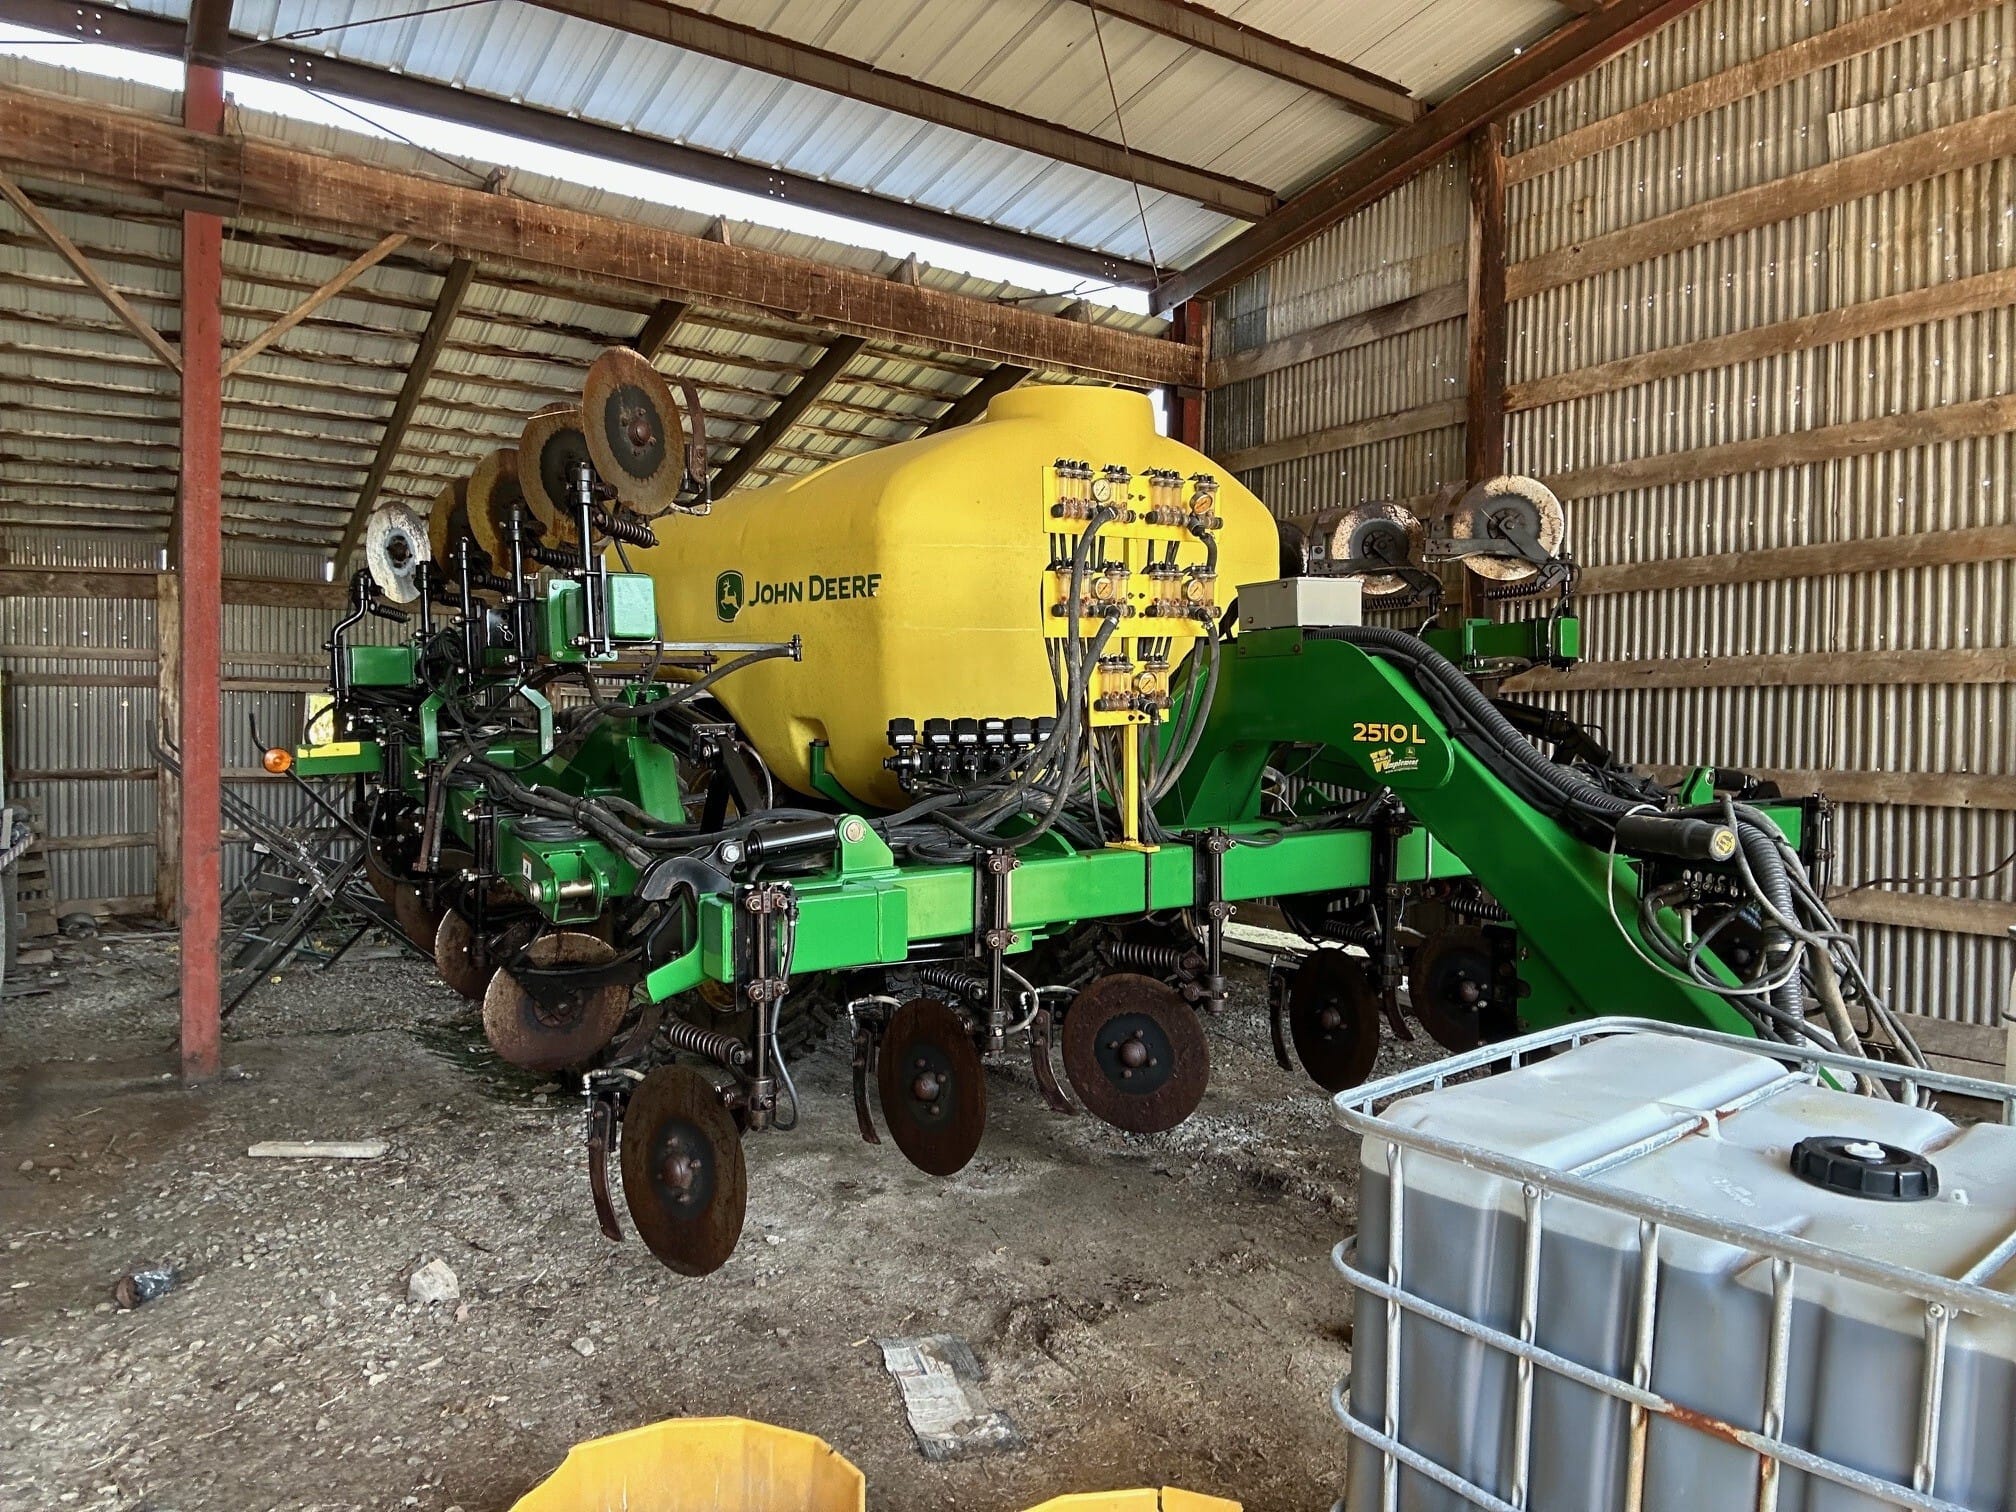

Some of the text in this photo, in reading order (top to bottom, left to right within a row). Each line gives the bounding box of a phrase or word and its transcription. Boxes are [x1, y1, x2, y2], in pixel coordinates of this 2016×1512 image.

[749, 574, 882, 606] JOHN DEERE
[1353, 722, 1426, 744] 2510 L
